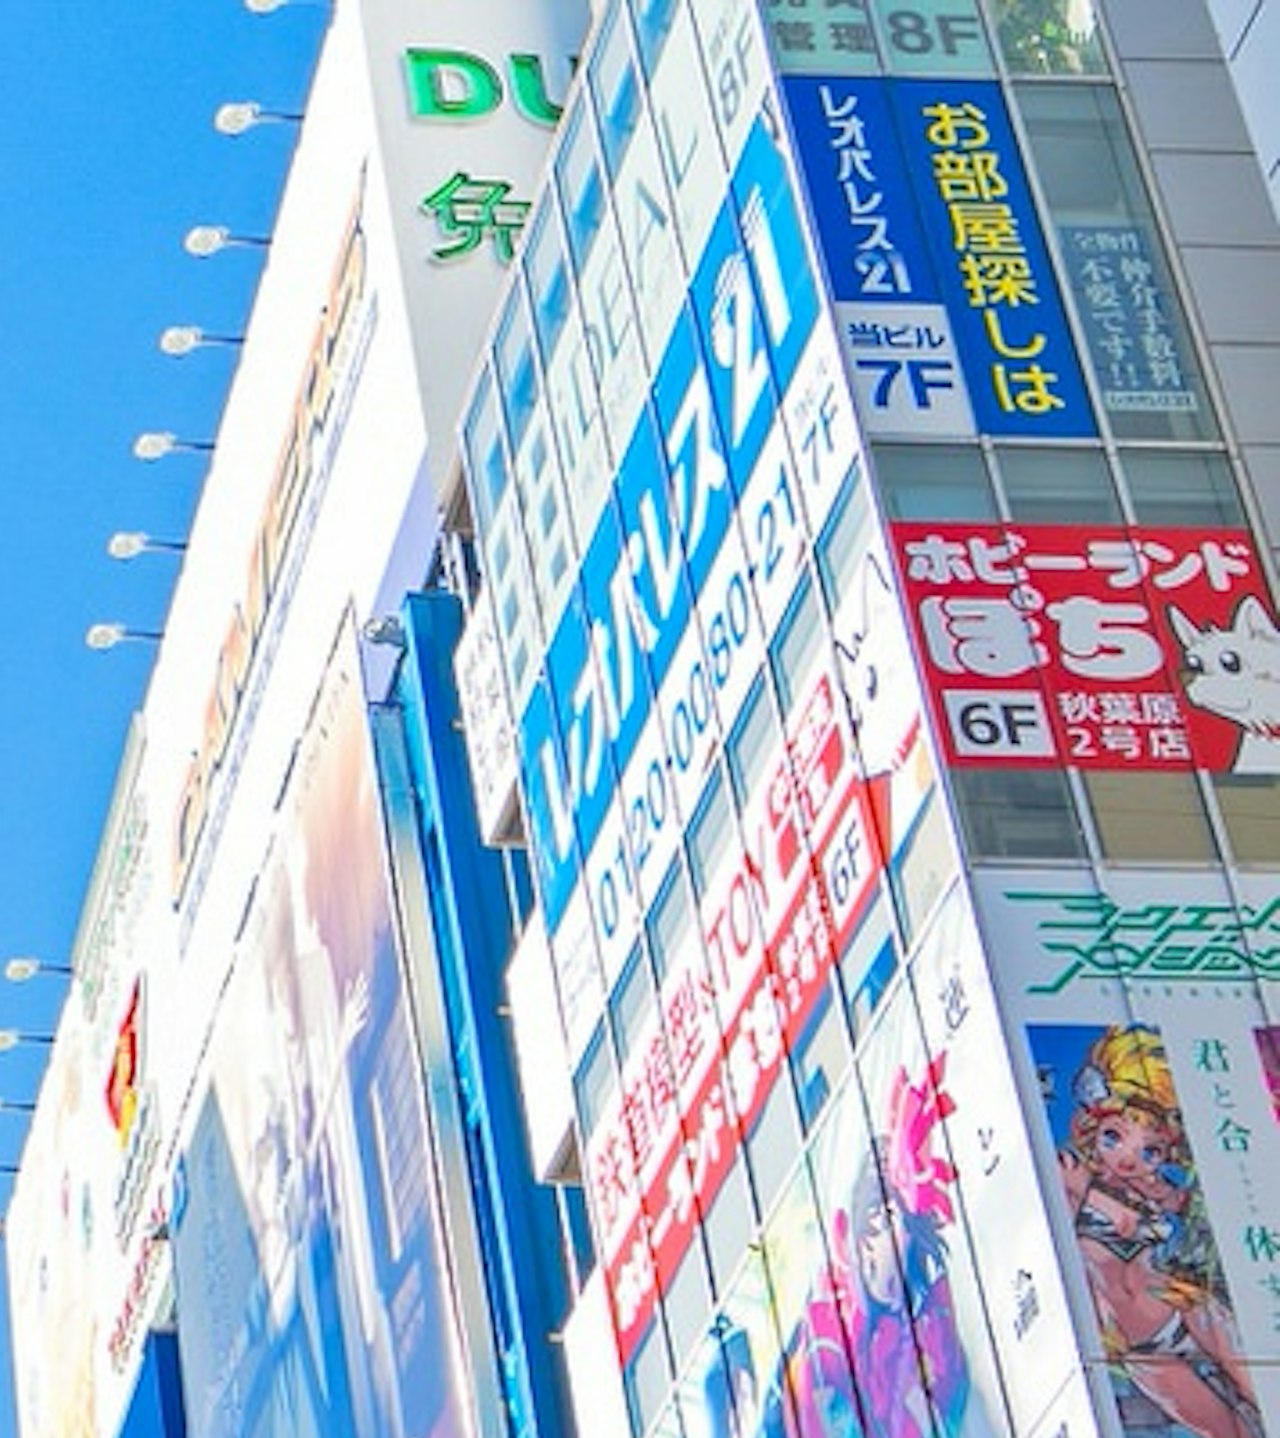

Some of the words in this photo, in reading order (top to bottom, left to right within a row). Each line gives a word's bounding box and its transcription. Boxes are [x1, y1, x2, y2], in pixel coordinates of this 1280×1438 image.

[887, 10, 983, 58] 8F
[820, 85, 912, 296] レオパレス21
[921, 102, 1067, 415] お部屋探しは
[847, 321, 946, 351] 当ビル
[856, 360, 955, 411] 7F
[533, 178, 798, 862] レオパレス21
[903, 533, 1252, 594] ホビーランド
[918, 586, 1166, 683] ぽち
[958, 699, 1040, 749] 6F
[1059, 691, 1186, 726] 秋葉原
[1065, 727, 1191, 762] 2号店
